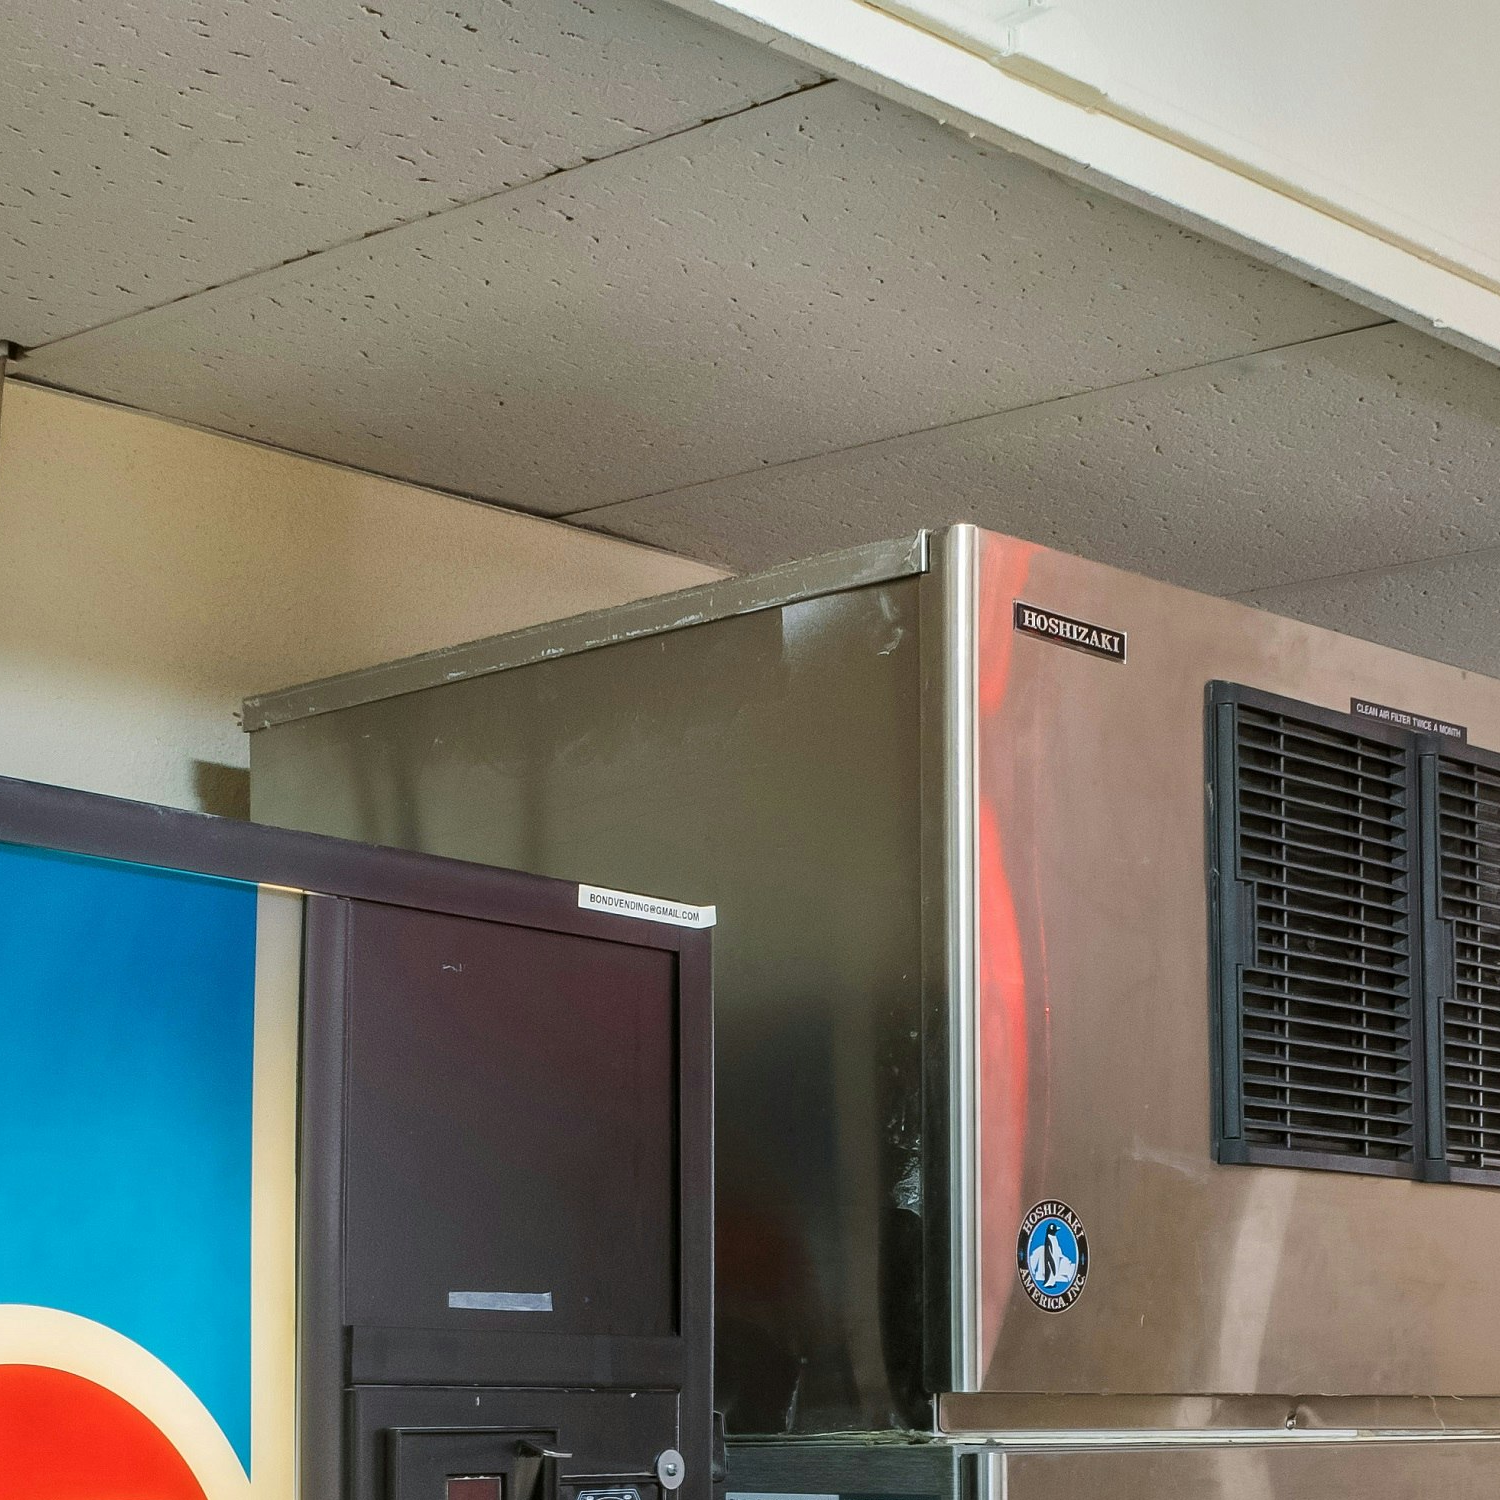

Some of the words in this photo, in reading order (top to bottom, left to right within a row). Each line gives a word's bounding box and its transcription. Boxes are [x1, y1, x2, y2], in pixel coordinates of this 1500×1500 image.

[1023, 609, 1119, 653] HOSHIZAKI
[1356, 703, 1378, 717] CLEAN
[1379, 709, 1390, 720] AIR
[1390, 711, 1411, 724] FILTER
[1412, 717, 1432, 731] TWICE
[1433, 723, 1438, 732] A
[1439, 725, 1461, 738] MONTH
[590, 893, 700, 921] BONDVENDING@GMAIL.COM
[1022, 1203, 1085, 1239] HOSHIZAKI
